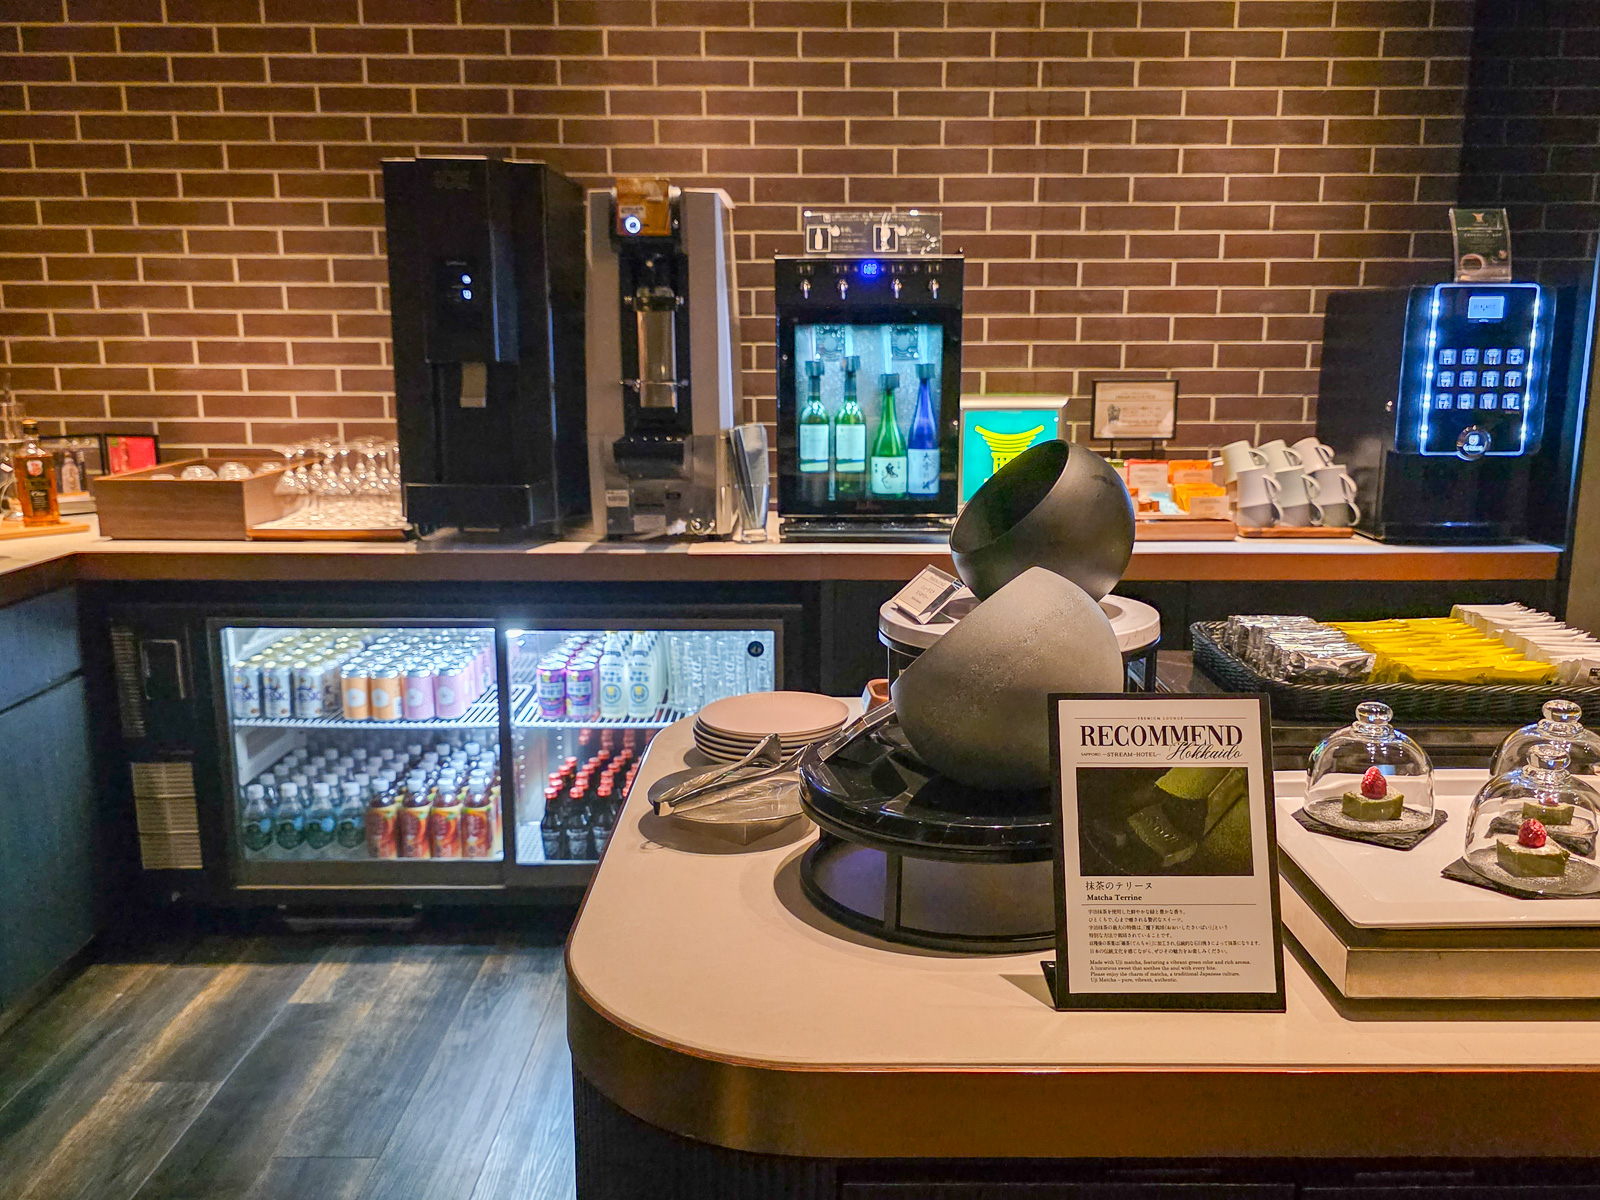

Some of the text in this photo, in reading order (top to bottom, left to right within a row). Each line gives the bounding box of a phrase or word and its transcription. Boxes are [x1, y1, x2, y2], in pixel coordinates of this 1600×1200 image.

[1080, 725, 1243, 747] RECOMMEND
[1166, 741, 1243, 760] Hokkaido
[1085, 881, 1153, 891] 抹茶のテリーヌ
